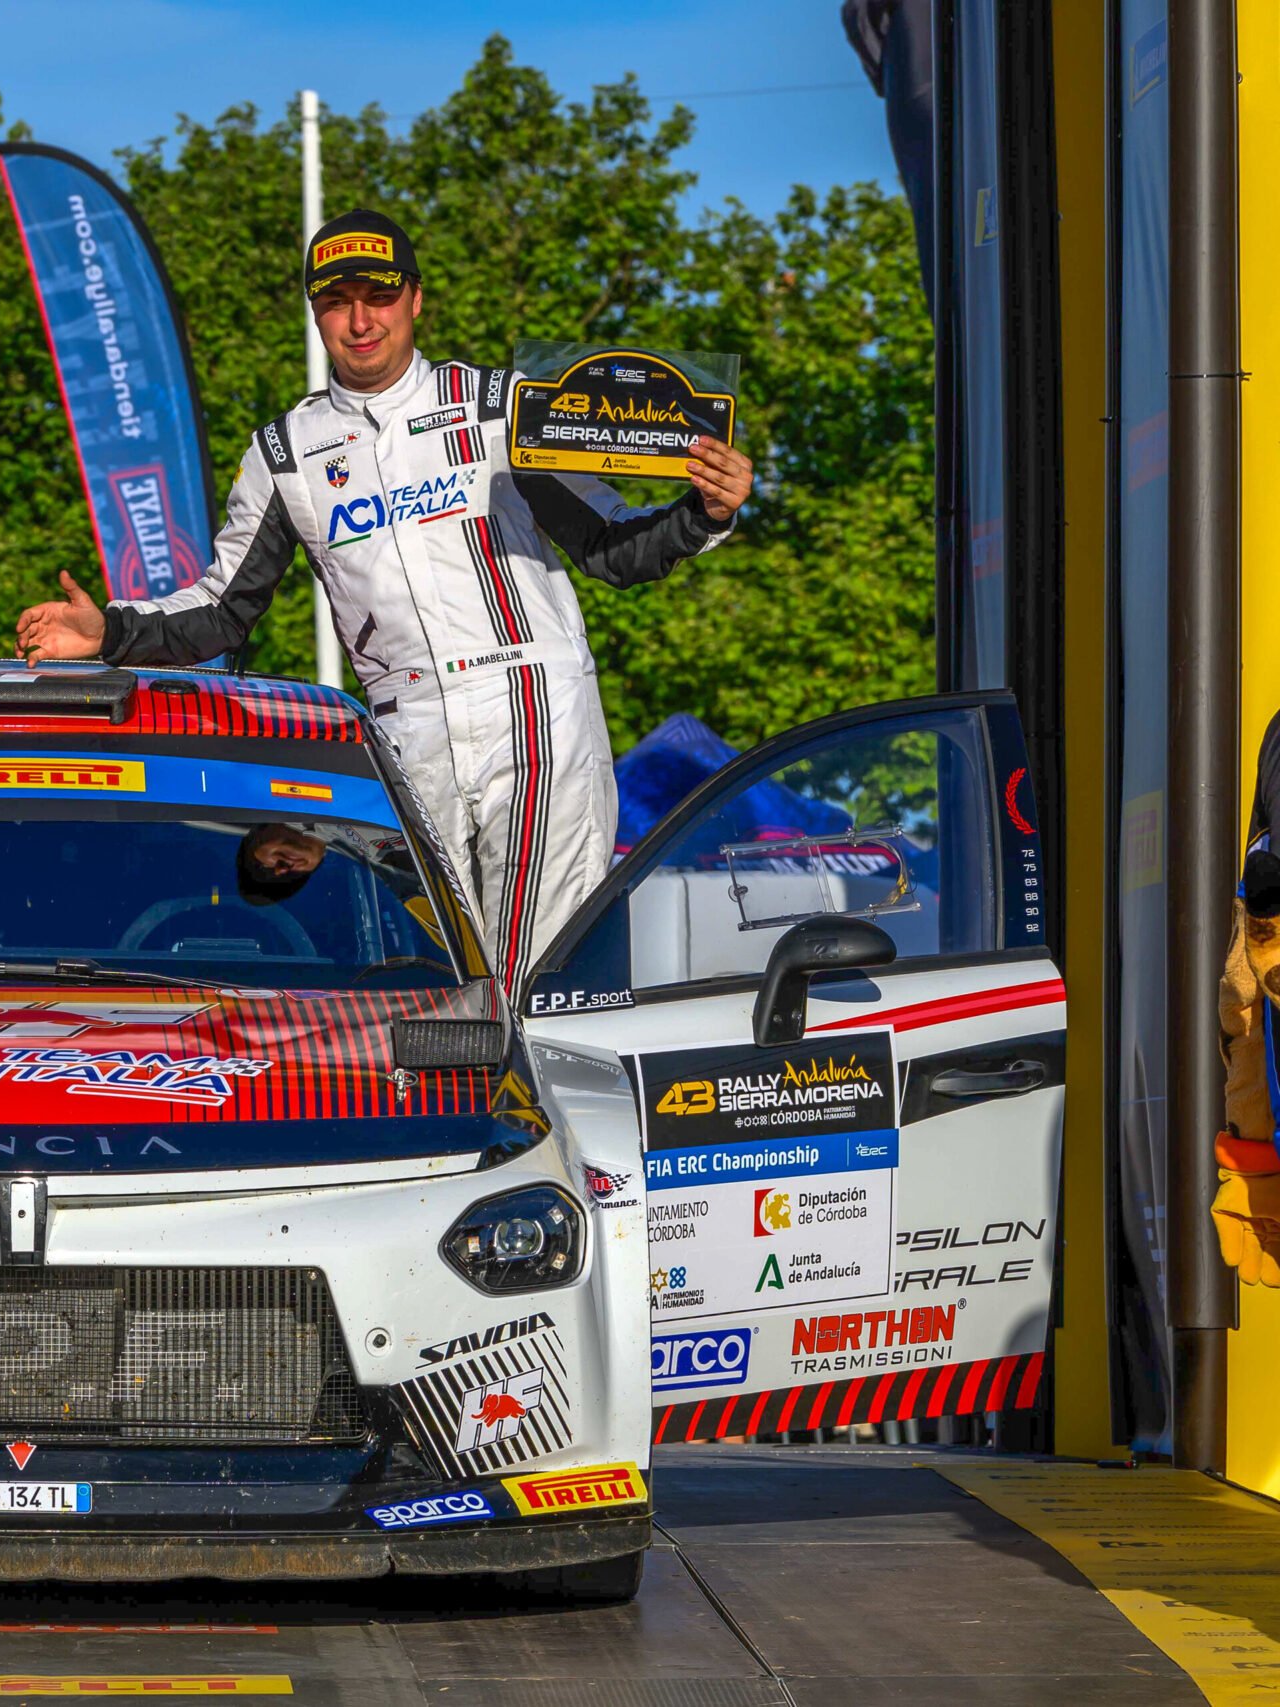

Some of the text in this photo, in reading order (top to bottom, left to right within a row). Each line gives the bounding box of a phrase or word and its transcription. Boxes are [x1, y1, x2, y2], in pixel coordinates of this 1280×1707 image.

[317, 234, 387, 263] PIRELLI
[615, 369, 646, 379] ERC
[487, 369, 503, 408] sparco
[550, 392, 590, 413] 43
[596, 394, 691, 427] Andalucía
[713, 401, 726, 410] FIA
[549, 411, 590, 420] RALLY
[266, 422, 287, 463] sparco
[542, 425, 613, 443] SIERRA
[617, 430, 700, 448] MORENA
[607, 444, 639, 454] CÓRDOBA
[389, 472, 457, 505] TEAM
[328, 494, 385, 542] ACI
[388, 490, 469, 526] ITALIA
[468, 650, 523, 669] A.MABELLINI
[1021, 849, 1036, 858] 72
[1022, 863, 1038, 872] 75
[1024, 878, 1038, 887] 83
[1024, 892, 1039, 902] 88
[1025, 907, 1039, 916] 90
[1026, 923, 1040, 932] 92
[2, 1047, 216, 1073] TEAM
[718, 1053, 872, 1097] RALLY Andalucía
[655, 1080, 716, 1116] 43
[718, 1081, 884, 1113] SIERRA MORENA
[770, 1109, 823, 1125] CÓRDOBA
[823, 1111, 856, 1121] HUMANIDAD
[859, 1145, 888, 1157] ERC
[646, 1145, 820, 1179] FIA ERC Championship
[799, 1187, 867, 1208] Diputación
[798, 1204, 868, 1225] de Córdoba
[648, 1222, 696, 1243] CÓRDOBA
[789, 1252, 822, 1267] Junta
[788, 1262, 861, 1283] de Andalucía
[662, 1289, 700, 1301] PATRIMONIO
[662, 1296, 705, 1309] HUMANIDAD
[791, 1345, 952, 1376] TRASMISSIONI
[8, 1486, 42, 1508] 134
[48, 1487, 73, 1509] TL
[520, 1469, 637, 1508] PIRELLI
[374, 1493, 484, 1527] sparco
